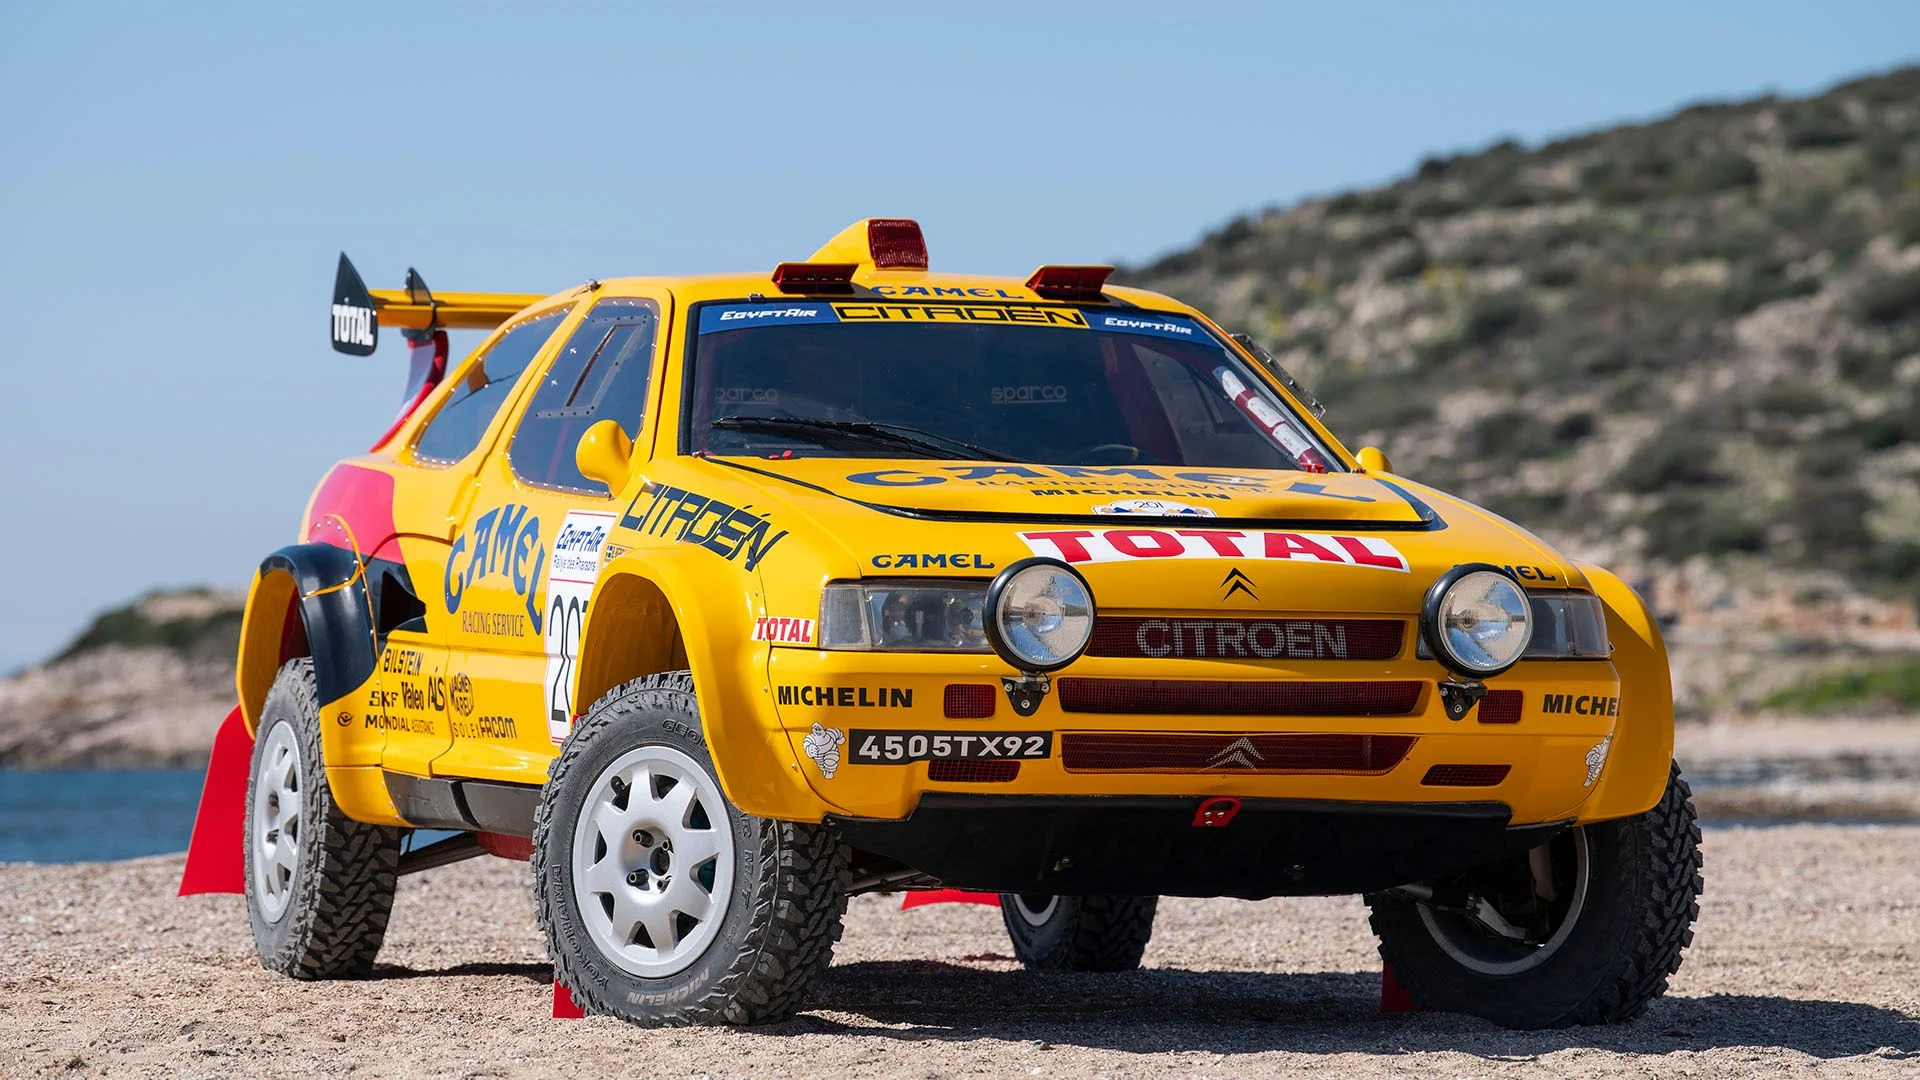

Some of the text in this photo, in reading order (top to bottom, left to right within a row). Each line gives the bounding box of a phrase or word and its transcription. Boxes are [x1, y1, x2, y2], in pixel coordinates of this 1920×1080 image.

[869, 285, 1024, 299] CAMEL
[332, 304, 374, 346] TOTAL
[991, 385, 1068, 402] sparco
[846, 466, 1377, 502] CAMEL
[976, 480, 1105, 488] RACING
[1031, 489, 1232, 500] MICHELIN
[1134, 501, 1164, 509] 201
[871, 553, 995, 569] CAMEL
[1023, 529, 1404, 570] TOTAL
[444, 504, 545, 636] CAMEL
[462, 610, 525, 637] RACING SERVICE
[756, 617, 811, 643] TOTAL
[1136, 619, 1348, 659] CITROEN
[384, 648, 423, 676] BILSTEIN
[549, 594, 588, 722] 20
[368, 690, 399, 708] SKF
[401, 681, 425, 710] Valeo
[778, 685, 913, 708] MICHELIN
[1542, 694, 1620, 717] MICHE
[365, 714, 411, 732] MONDIAL
[859, 734, 1044, 761] 4505TX92
[552, 864, 609, 991] YOKOHAMA
[627, 967, 710, 1006] MICHELIN
